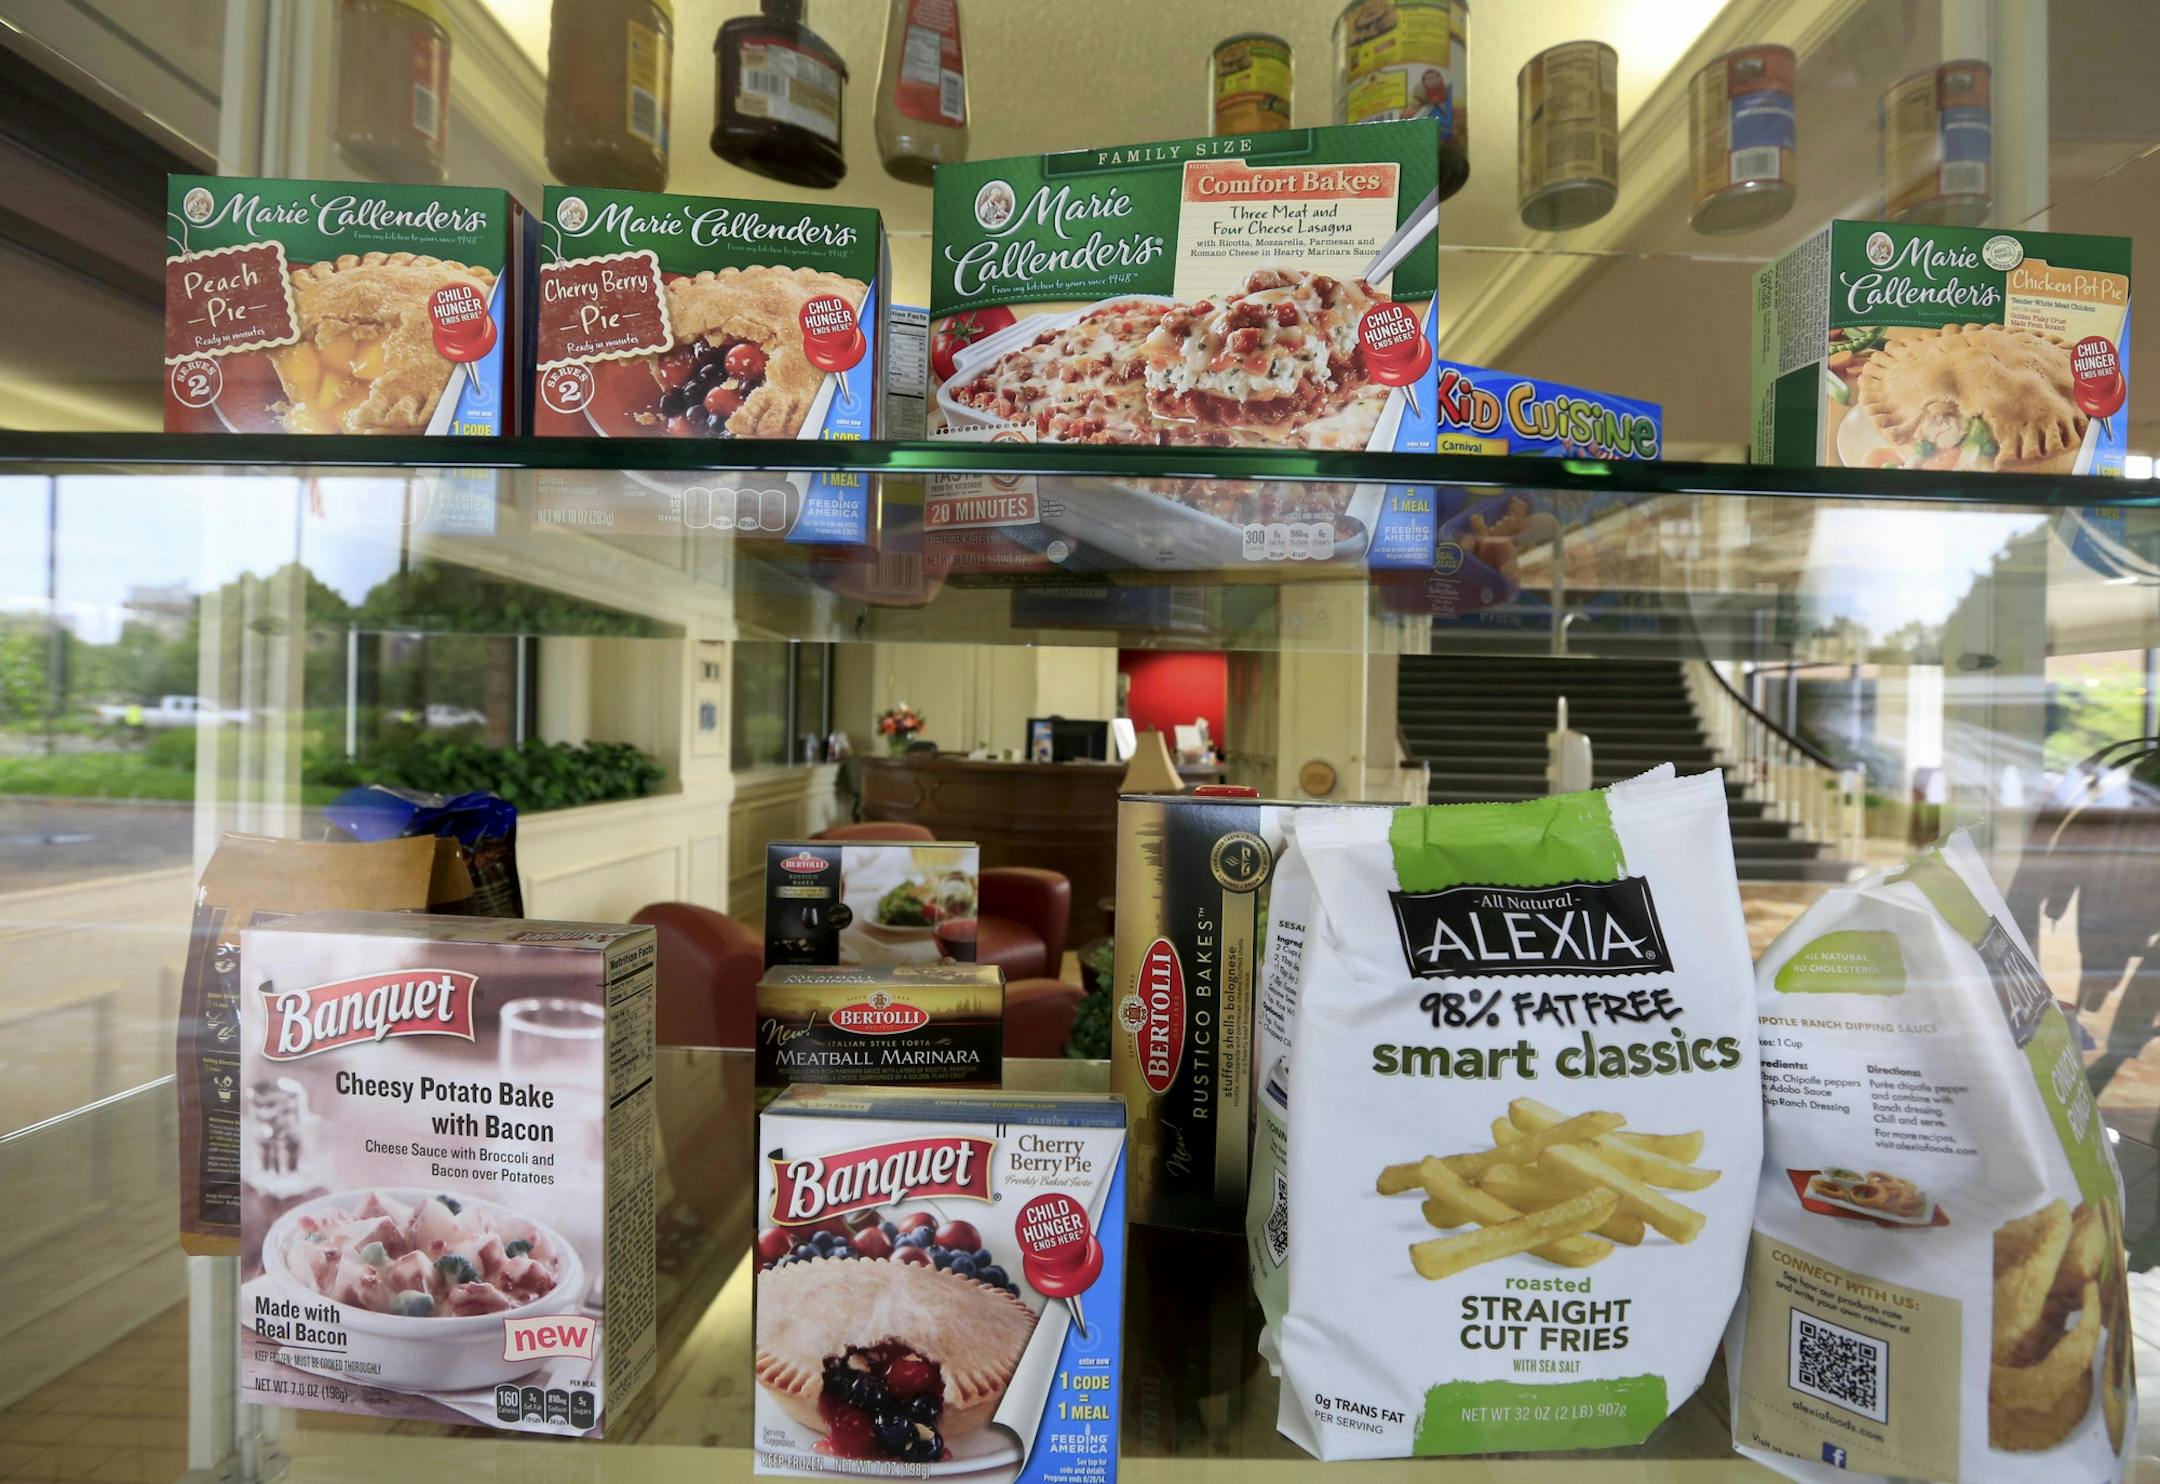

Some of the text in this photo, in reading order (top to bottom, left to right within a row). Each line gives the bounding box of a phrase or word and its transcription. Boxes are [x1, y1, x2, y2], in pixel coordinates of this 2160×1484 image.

[1098, 139, 1253, 165] FAMILY SIZE
[1199, 171, 1382, 195] Comfort Bakes
[191, 193, 309, 237] Marie
[997, 185, 1133, 240] Marie
[1230, 203, 1338, 219] Three Meat and
[564, 202, 682, 245] Marie
[1213, 218, 1352, 236] Four Cheese Lasagna
[1190, 249, 1226, 257] Romano
[1229, 248, 1260, 256] Cheese
[1273, 248, 1304, 257] Hearty
[1307, 248, 1351, 256] Marinara
[1353, 248, 1380, 256] Sauce
[1197, 238, 1375, 247] with Ricotta, Mozzarella, Parmesan and
[1873, 236, 1978, 280] Marie
[184, 264, 259, 298] Peach
[544, 269, 648, 303] Cherry Berry
[2012, 269, 2122, 300] Chicken Pot Pie
[436, 286, 472, 302] CHILD
[2011, 297, 2033, 306] Tender
[2035, 300, 2053, 308] White
[2071, 304, 2096, 312] Chicken
[207, 298, 247, 327] Pie
[433, 299, 481, 319] HUNGER
[807, 298, 843, 315] CHILD
[1366, 304, 1403, 329] CHILD
[579, 306, 620, 335] Pie
[804, 311, 852, 329] HUNGER
[1364, 318, 1415, 343] HUNGER
[195, 333, 222, 347] Ready
[233, 326, 265, 340] minutes
[567, 339, 595, 354] Ready
[605, 334, 639, 347] minutes
[2077, 341, 2107, 357] CHILD
[177, 360, 217, 383] SERVES
[2074, 354, 2115, 372] HUNGER
[188, 375, 210, 397] 2
[547, 366, 588, 389] SERVES
[558, 380, 582, 403] 2
[1442, 440, 1482, 453] Carnival
[808, 500, 859, 508] FEEDING
[808, 509, 858, 517] AMERICA
[931, 505, 949, 523] 20
[956, 498, 1027, 521] MINUTES
[1245, 530, 1265, 545] 300
[786, 860, 824, 869] BERTOLLI
[1481, 893, 1573, 910] All Natural
[610, 944, 654, 970] Nutrition Facts
[1805, 953, 1869, 963] ALL NATURAL
[1793, 964, 1882, 976] NO CHOLESTEROL
[274, 975, 456, 1055] Banquet
[840, 1010, 919, 1025] BERTOLLI
[1147, 954, 1172, 1078] BERTOLLI
[1420, 988, 1683, 1028] 98% FAT FREE
[762, 1012, 817, 1046] New!
[1225, 946, 1239, 1098] stuffed shells bolognese
[776, 1050, 980, 1065] MEATBALL MARINARA
[1193, 1010, 1210, 1119] RUSTICO
[1373, 1027, 1743, 1079] smart classics
[336, 1071, 554, 1108] Cheesy Potato Bake
[1770, 1084, 1832, 1097] Adobo Sauce
[432, 1114, 554, 1142] with Bacon
[365, 1139, 554, 1166] Cheese Sauce with Broccoli and
[1018, 1134, 1085, 1158] Cherry
[431, 1164, 554, 1185] Bacon over Potatoes
[1011, 1153, 1092, 1177] Berry Pie
[787, 1140, 974, 1221] Banquet
[1026, 1200, 1069, 1224] CHILD
[1023, 1215, 1084, 1243] HUNGER
[1506, 1277, 1591, 1293] roasted
[1772, 1250, 1920, 1311] CONNECT WITH US:
[255, 1296, 340, 1324] Made with
[1461, 1296, 1631, 1324] STRAIGHT
[255, 1317, 348, 1347] Real Bacon
[514, 1325, 588, 1351] new
[1461, 1325, 1629, 1352] CUT FRIES
[1513, 1359, 1581, 1373] WITH SEA SALT
[1060, 1371, 1110, 1390] 1 CODE
[499, 1391, 518, 1407] 160
[1058, 1401, 1110, 1420] 1 MEAL
[1315, 1393, 1406, 1424] 0g TRANS FAT
[1315, 1409, 1384, 1435] PER SERVING
[1461, 1403, 1627, 1423] NET WT 32 OZ (2 LB) 907g
[1793, 1401, 1884, 1443] alexiafoods.com
[1050, 1444, 1107, 1454] AMERICA
[1051, 1434, 1107, 1444] FEEDING
